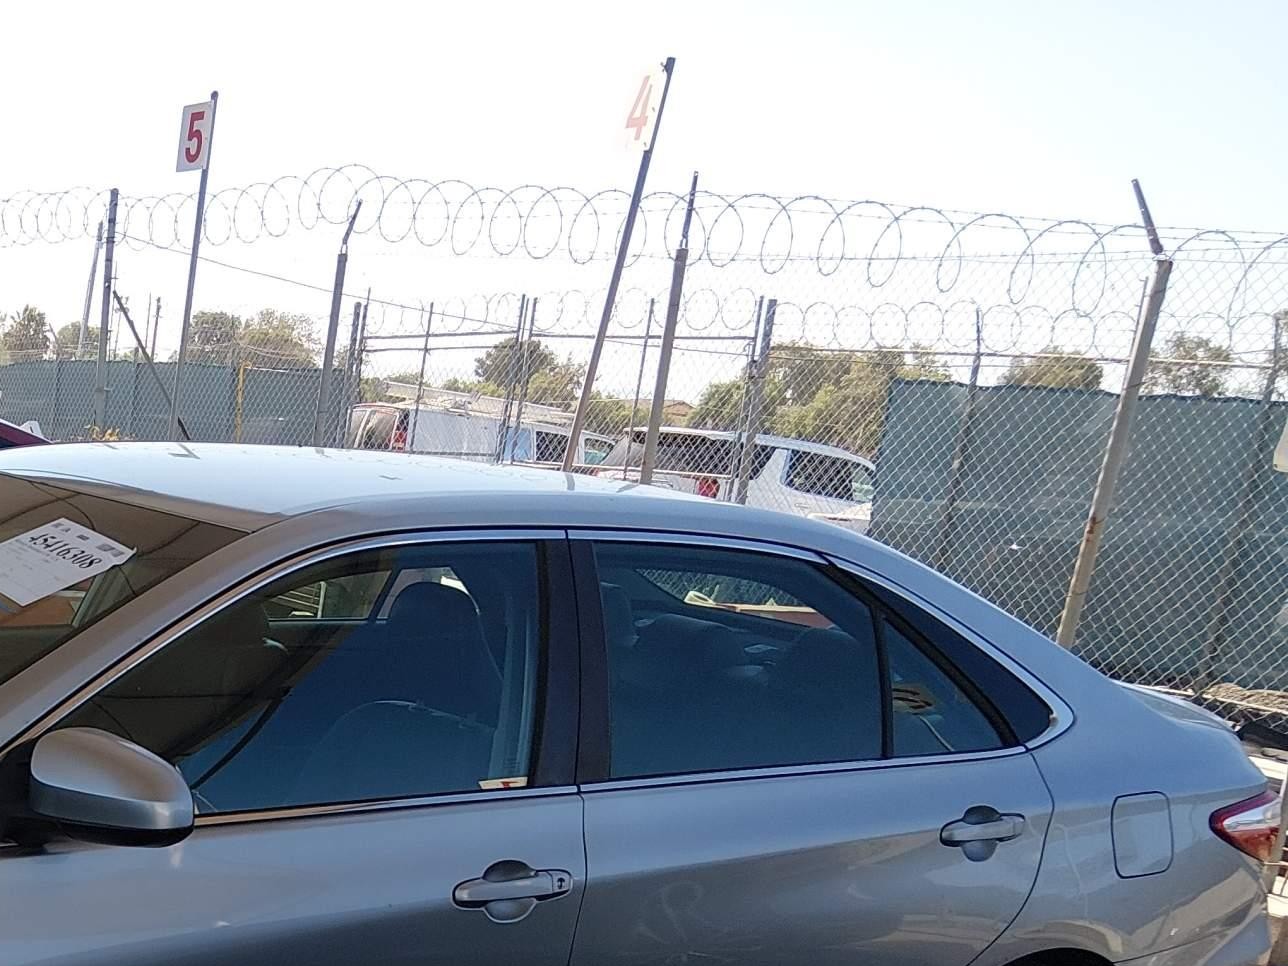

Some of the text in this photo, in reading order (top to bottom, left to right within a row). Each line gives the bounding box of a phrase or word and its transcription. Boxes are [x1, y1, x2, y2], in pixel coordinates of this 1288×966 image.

[626, 75, 651, 140] 4
[185, 111, 205, 163] 5
[29, 533, 103, 569] 45416308
